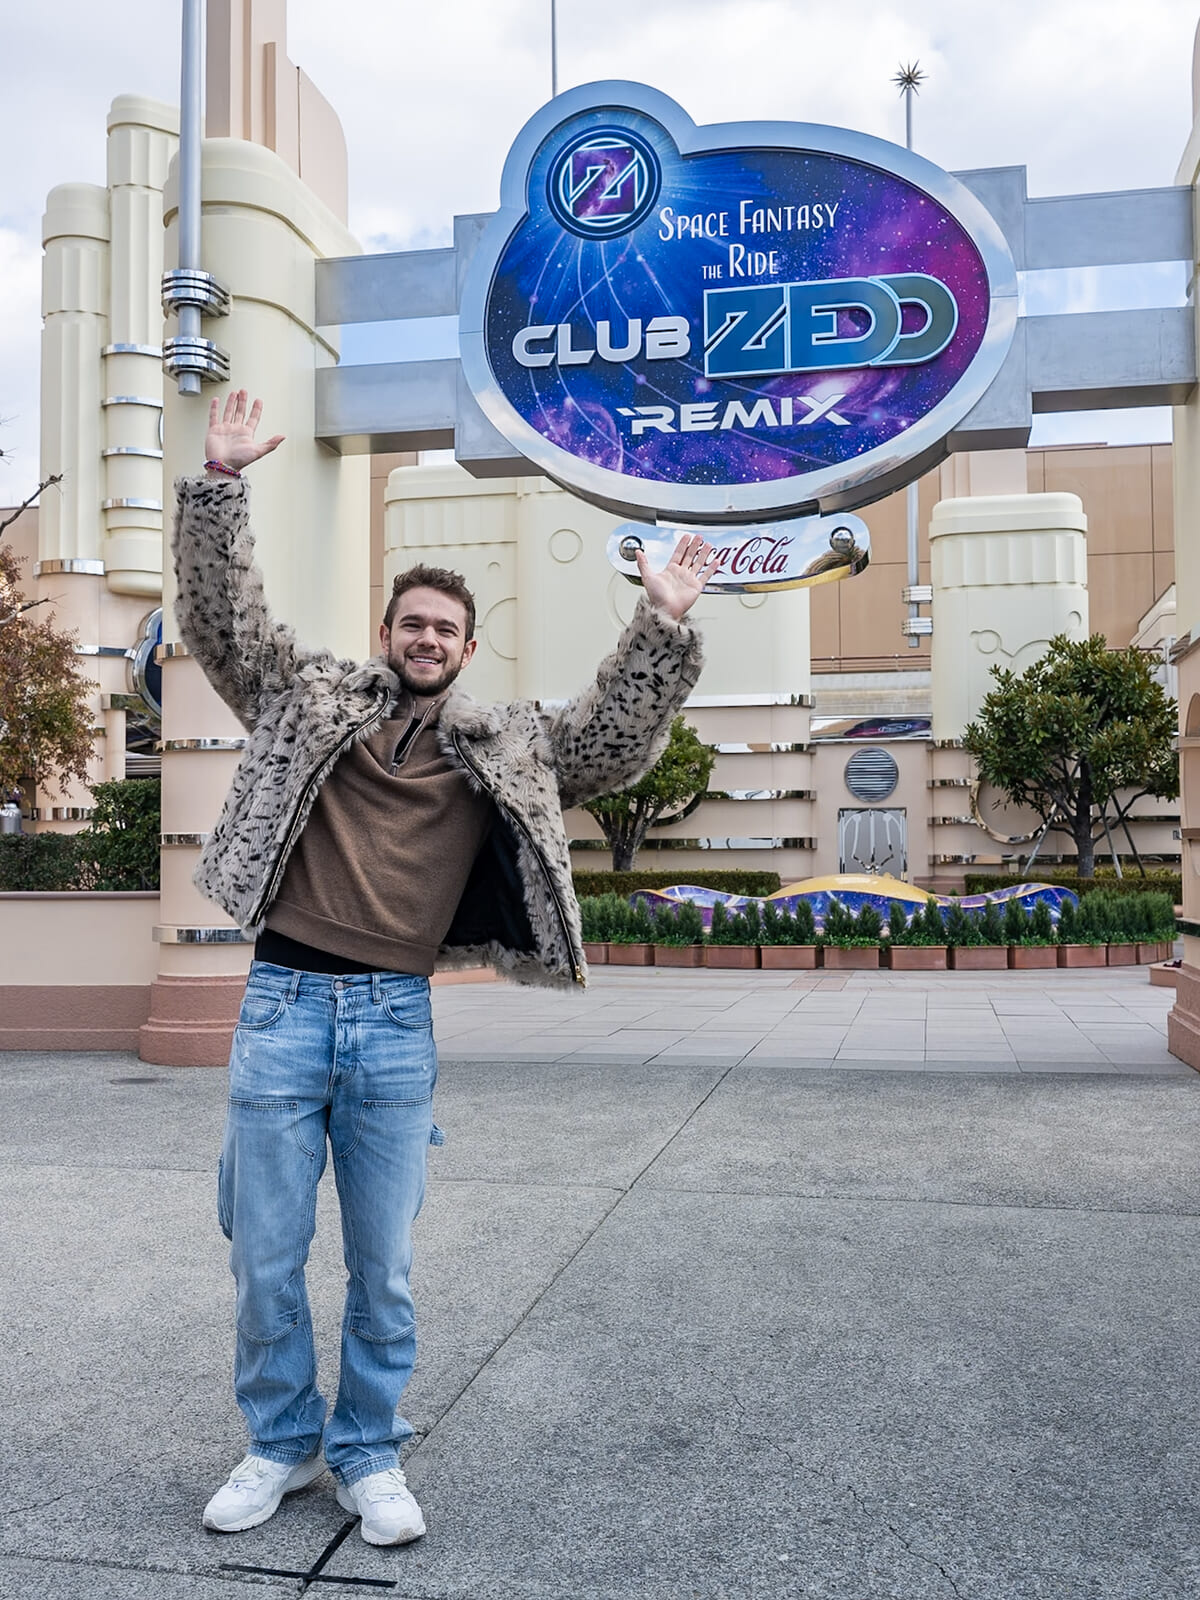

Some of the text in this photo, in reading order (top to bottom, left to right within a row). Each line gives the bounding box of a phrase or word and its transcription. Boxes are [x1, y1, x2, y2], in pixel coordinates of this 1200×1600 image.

[658, 200, 839, 241] SPACE FANTASY
[702, 243, 779, 280] THE RIDE
[512, 272, 959, 378] CLUB ZEDD
[615, 393, 851, 436] REMIX
